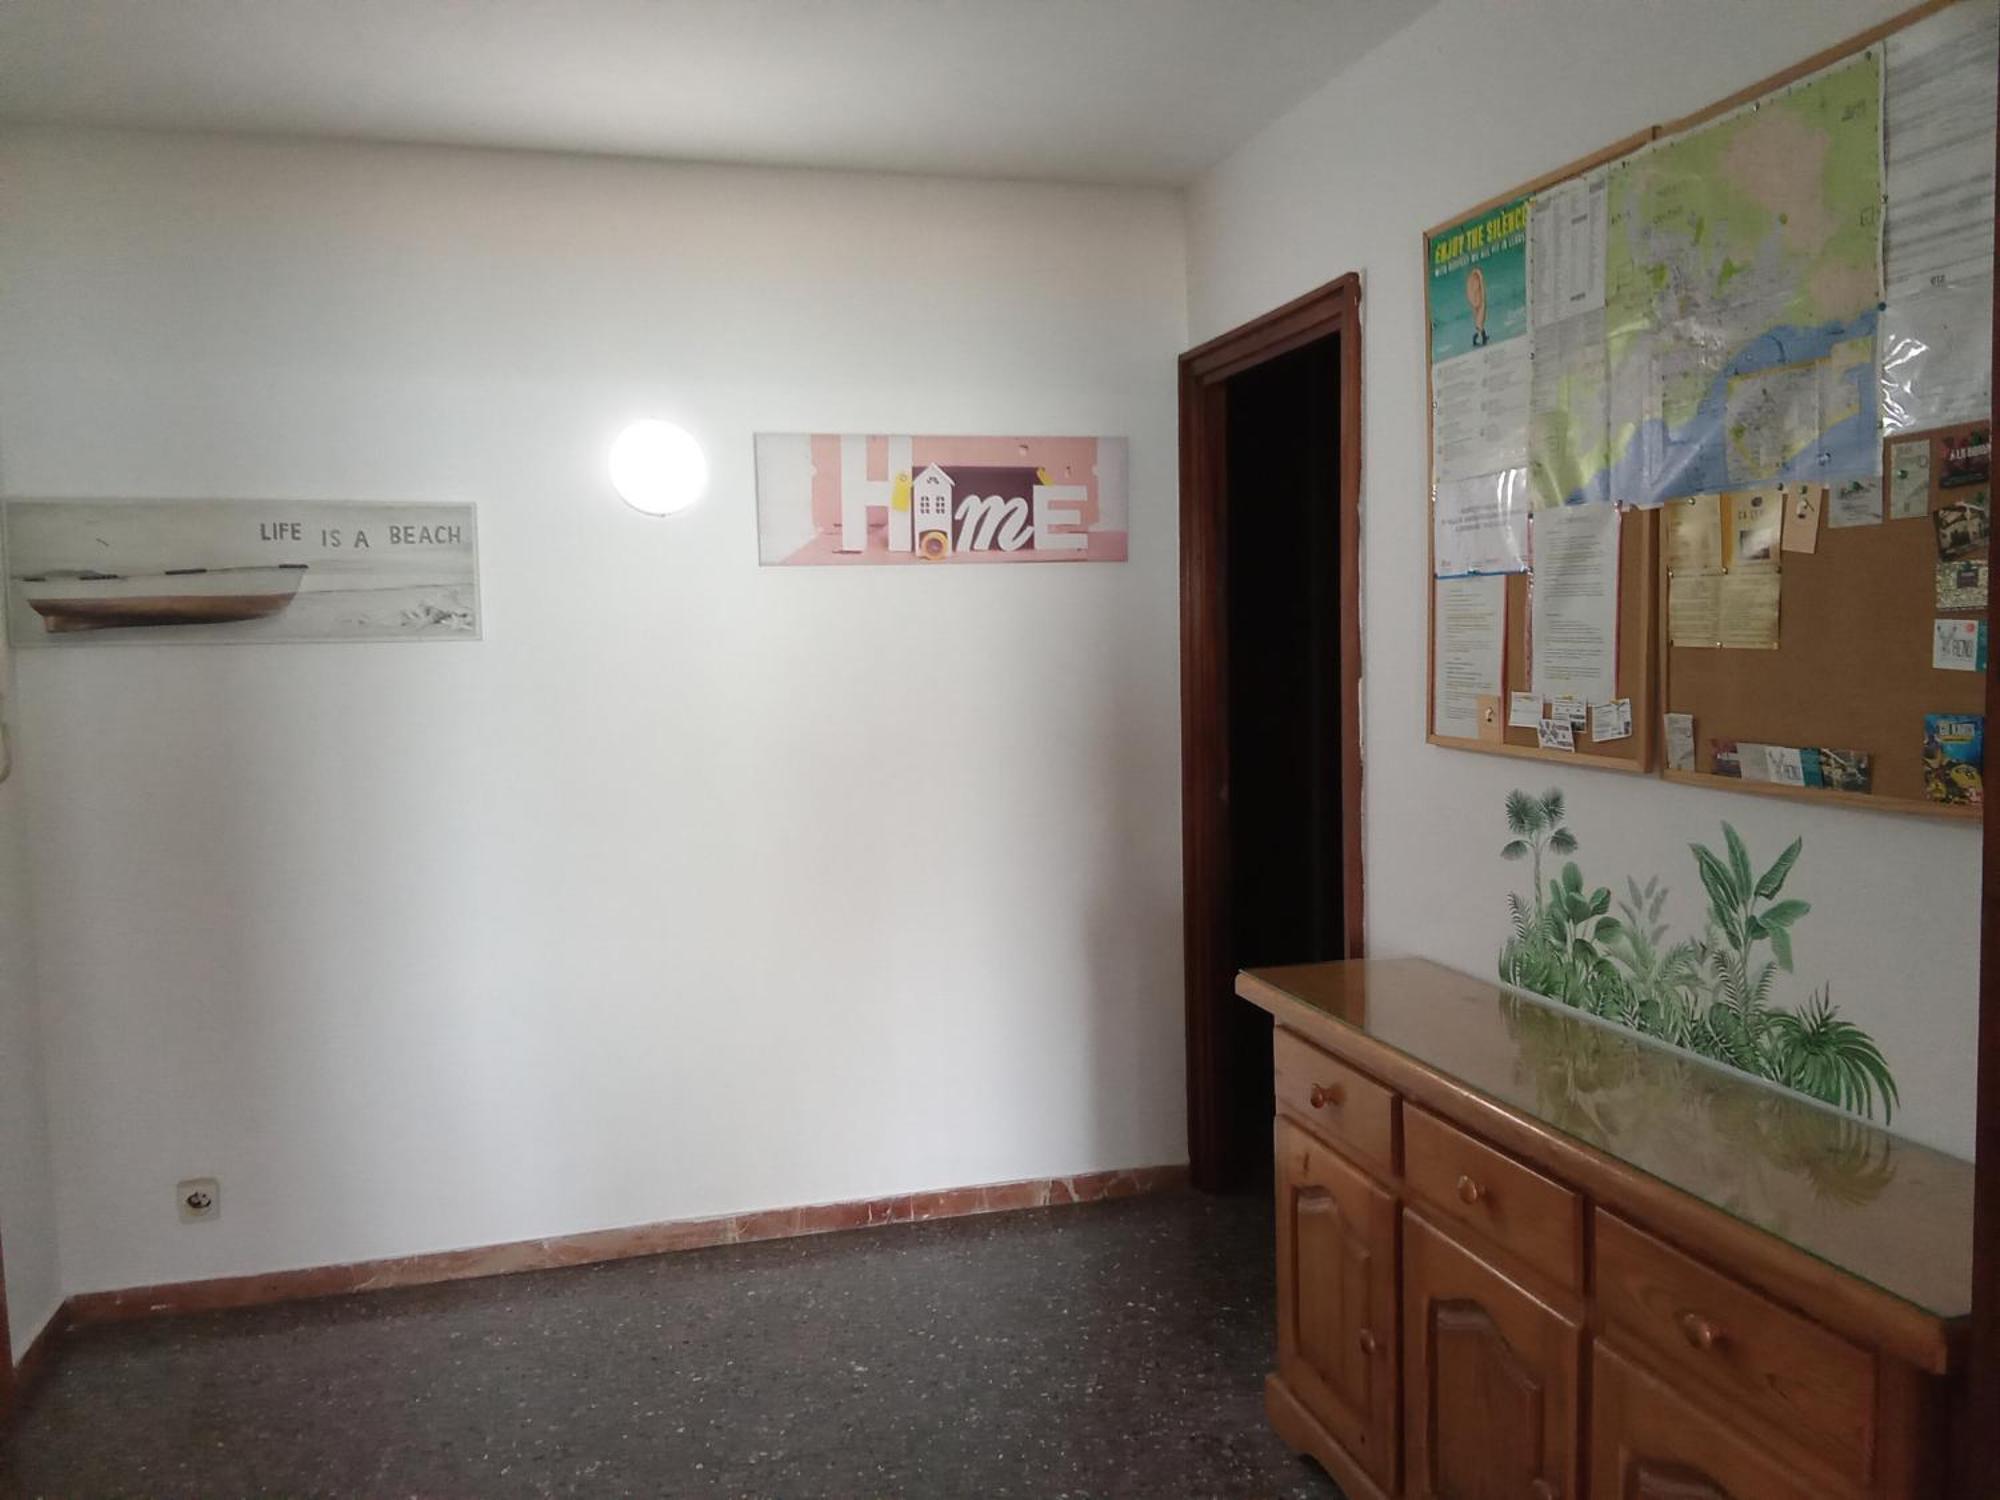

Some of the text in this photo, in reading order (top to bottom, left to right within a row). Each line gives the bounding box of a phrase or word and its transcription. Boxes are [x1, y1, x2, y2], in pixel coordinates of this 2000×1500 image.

[1434, 234, 1465, 264] ENJOY
[1466, 223, 1484, 252] THE
[260, 522, 461, 548] LIFE IS A BEACH
